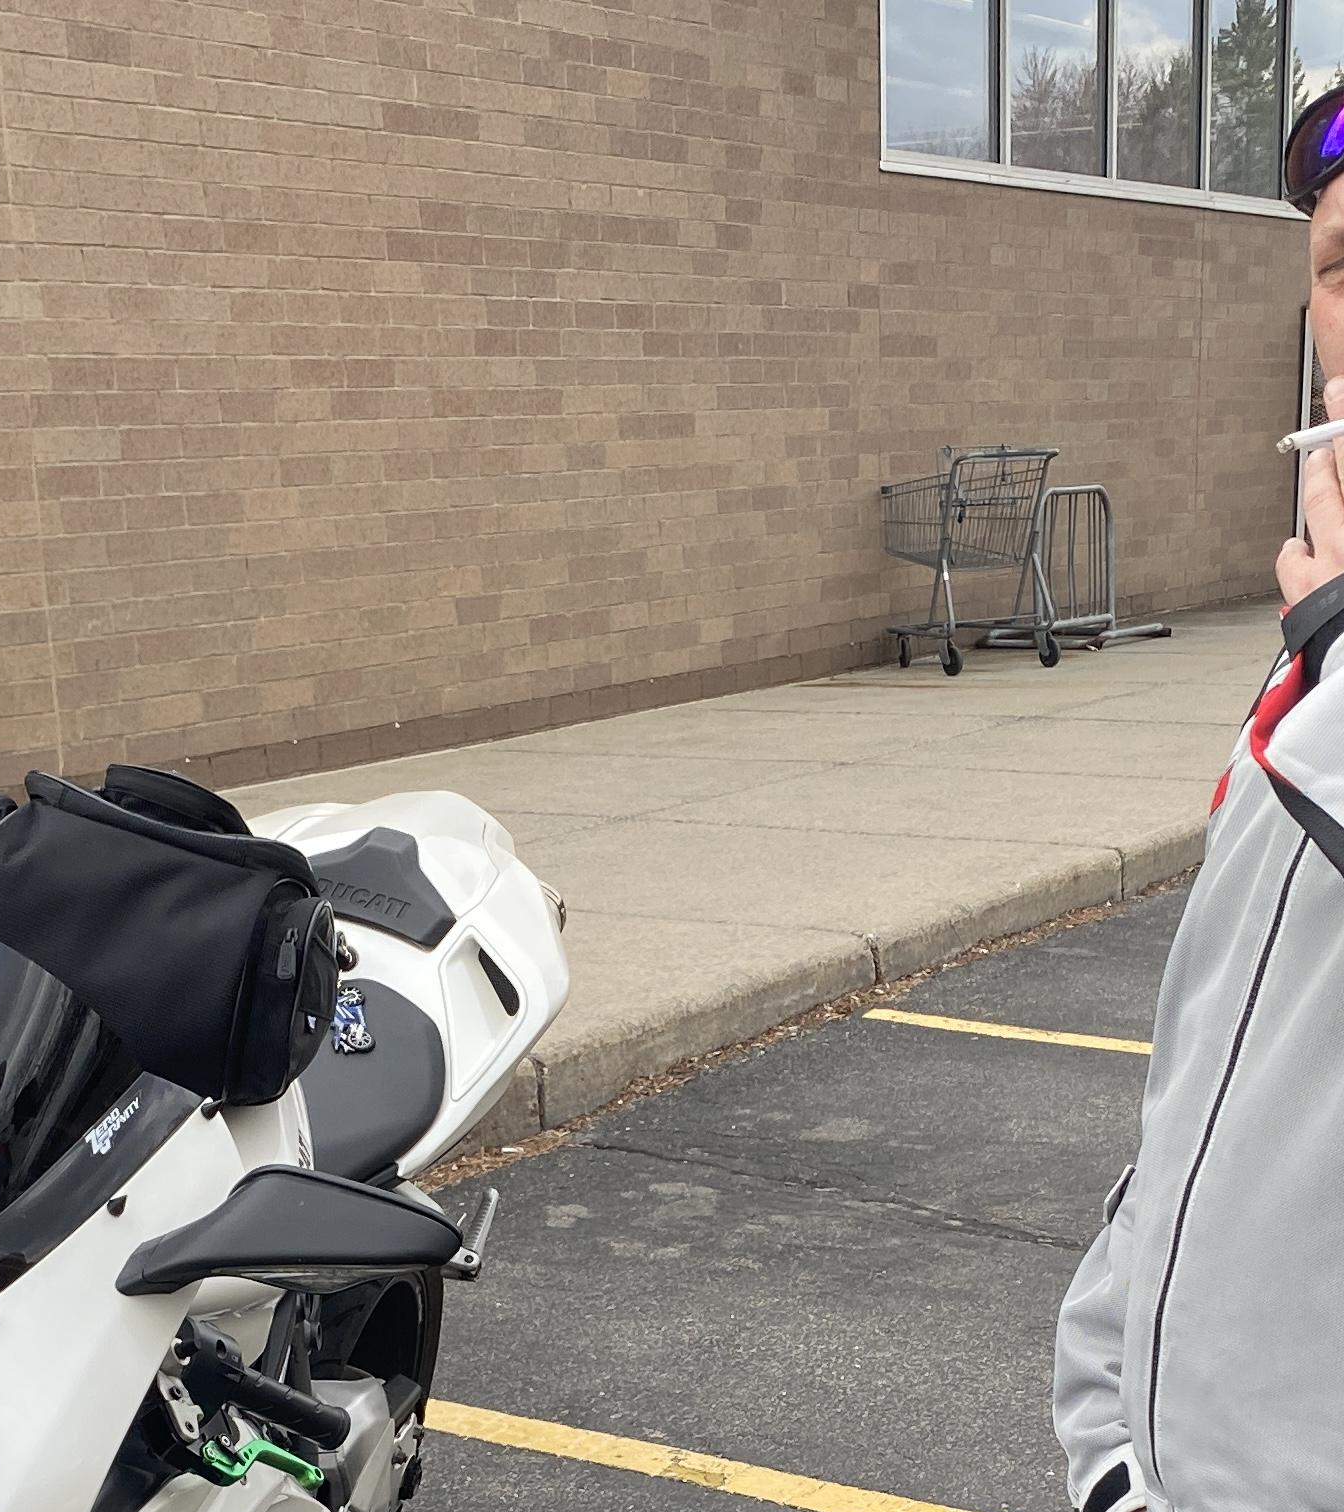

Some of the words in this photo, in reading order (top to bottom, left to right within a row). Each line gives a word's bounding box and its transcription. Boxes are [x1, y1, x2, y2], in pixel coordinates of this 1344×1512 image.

[317, 877, 412, 918] DUCATI
[85, 1107, 121, 1154] ZERO
[97, 1096, 140, 1155] GRAVITY
